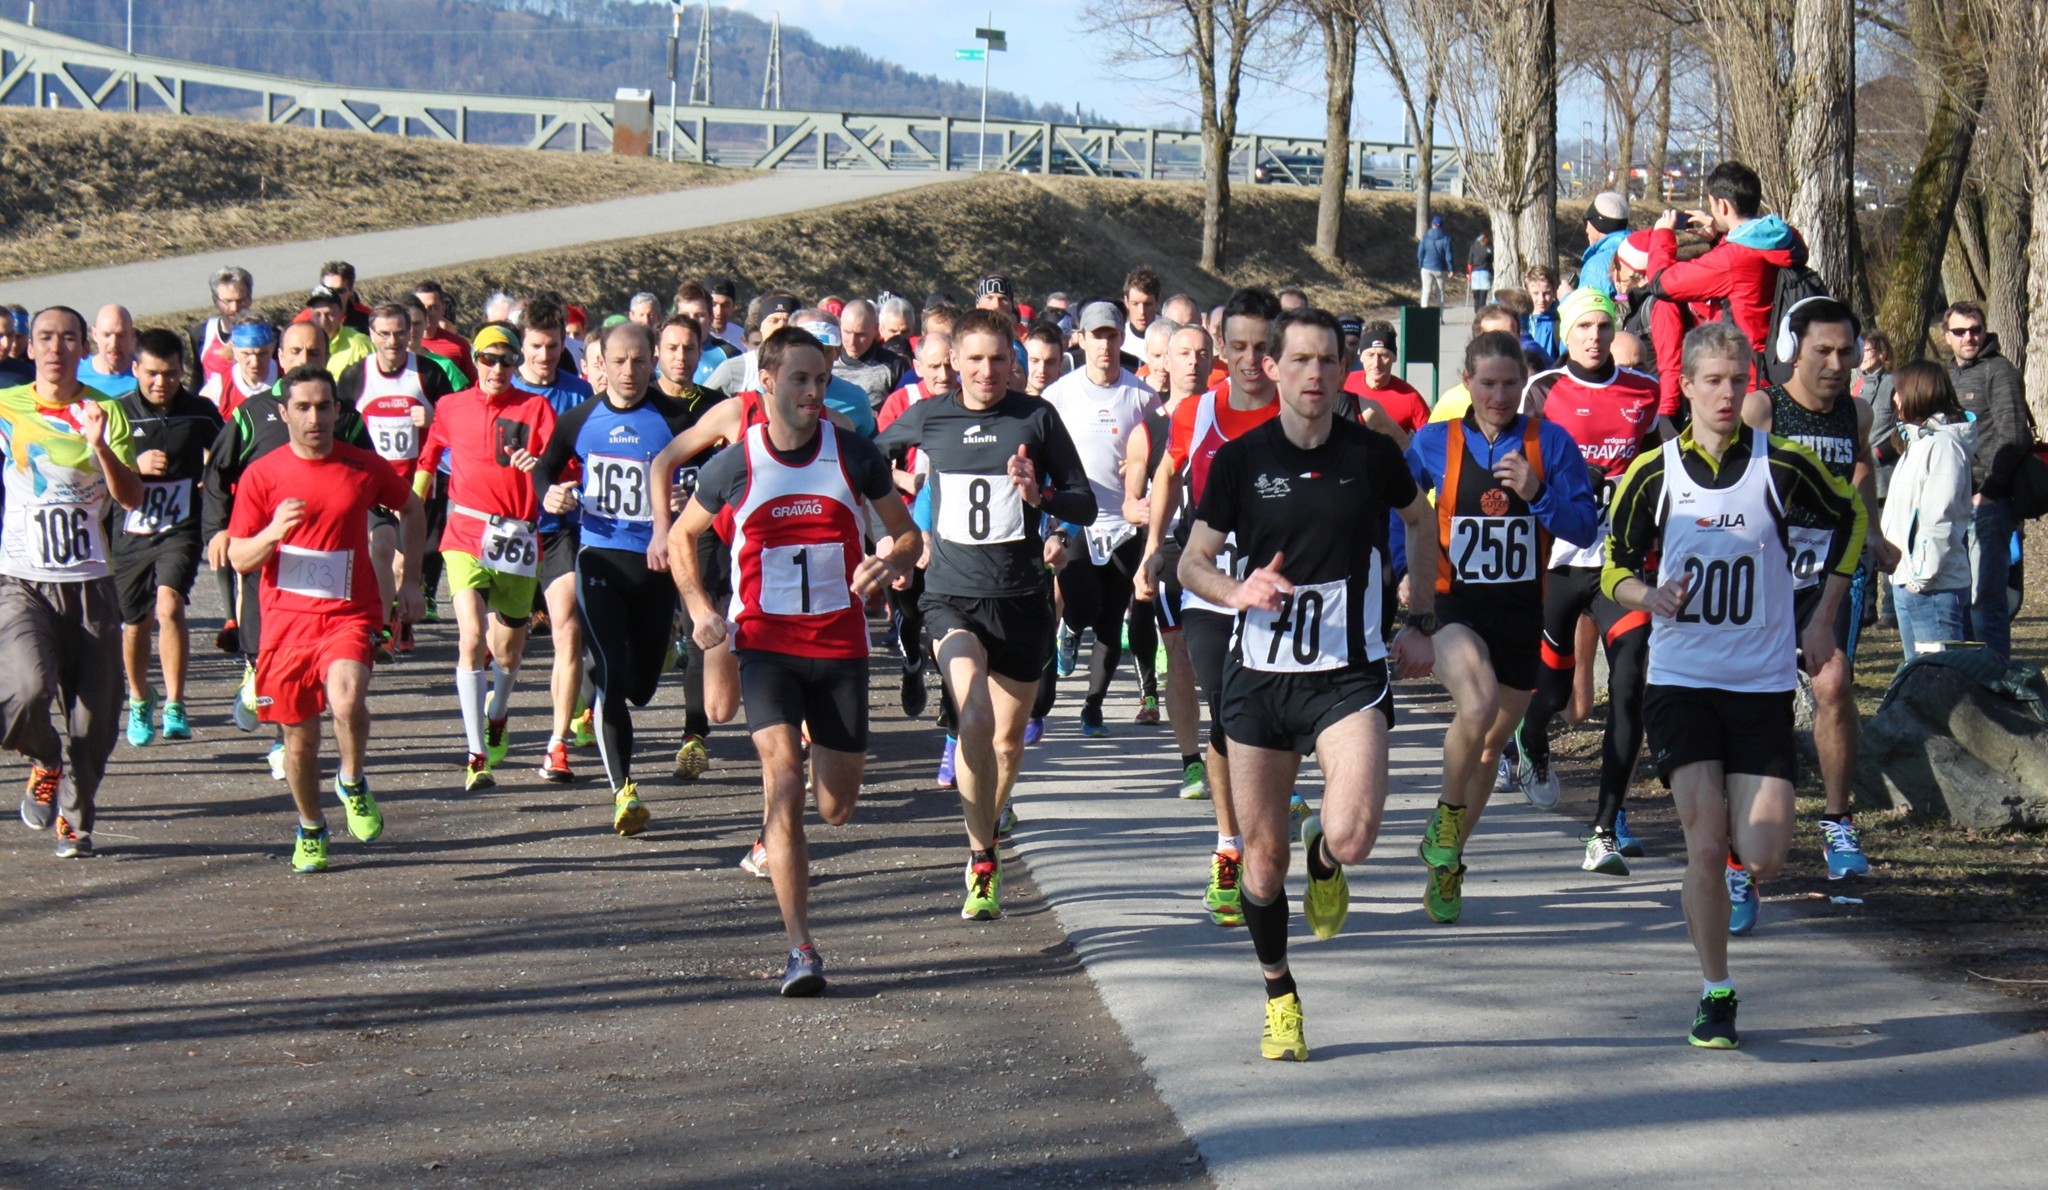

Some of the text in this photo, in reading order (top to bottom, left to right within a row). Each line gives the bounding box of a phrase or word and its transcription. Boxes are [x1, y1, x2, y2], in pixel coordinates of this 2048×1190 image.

[379, 431, 408, 452] 50
[609, 436, 639, 444] skinfit
[963, 435, 997, 443] skinfit
[139, 485, 181, 527] 184
[593, 462, 643, 517] 163
[969, 478, 990, 540] 8
[772, 504, 822, 518] GRAVAG
[1716, 514, 1745, 528] JLA
[34, 508, 92, 565] 106
[488, 534, 536, 566] 366
[1458, 518, 1529, 580] 256
[288, 559, 334, 589] 183
[793, 548, 810, 613] 1
[1677, 556, 1754, 625] 200
[1266, 589, 1323, 665] 70
